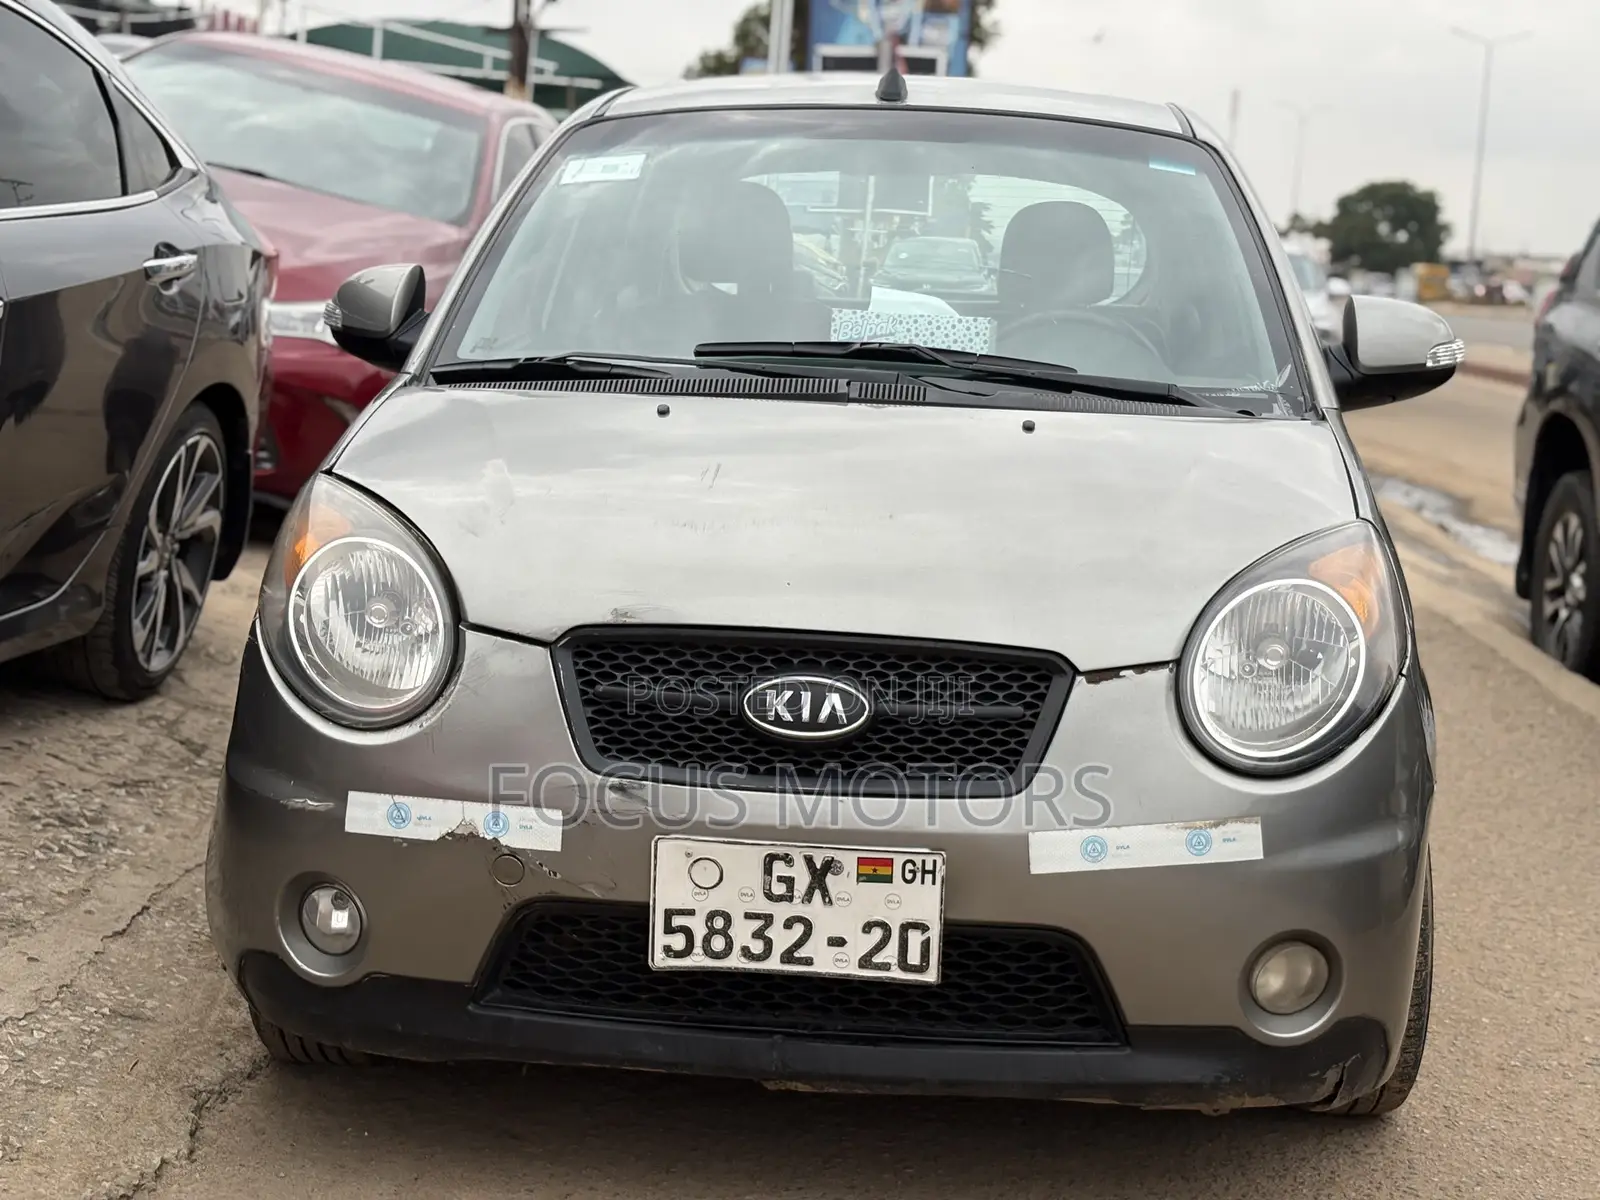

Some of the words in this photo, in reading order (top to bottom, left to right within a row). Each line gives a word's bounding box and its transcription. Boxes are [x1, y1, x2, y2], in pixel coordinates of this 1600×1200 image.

[838, 317, 897, 341] Belpak
[765, 690, 848, 725] KIA
[762, 852, 835, 906] GX
[901, 859, 937, 885] GH
[662, 908, 931, 973] 5832-20
